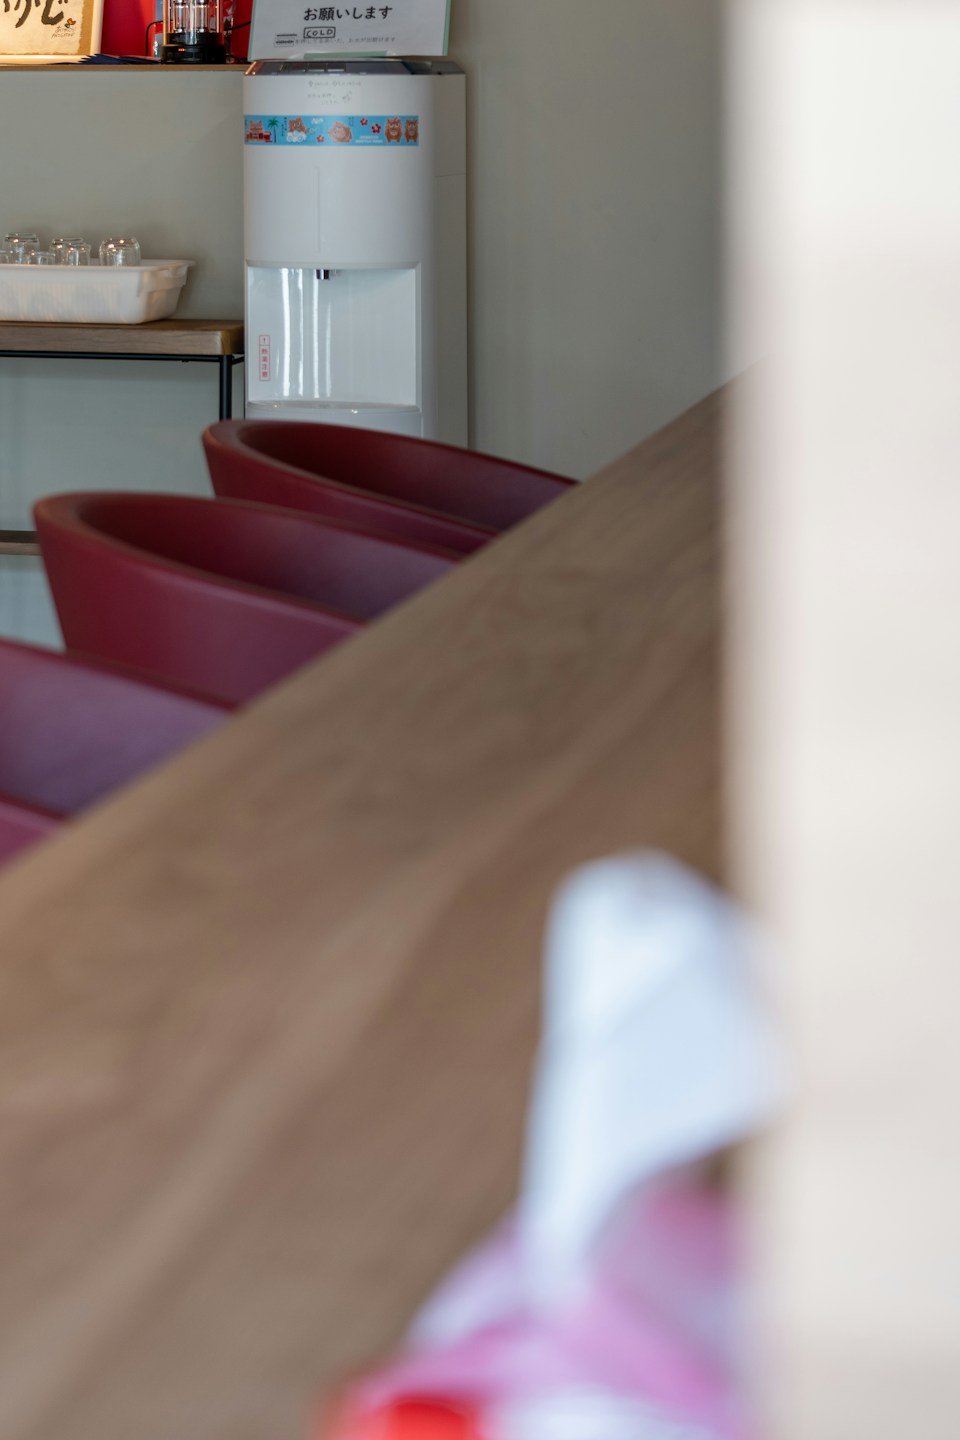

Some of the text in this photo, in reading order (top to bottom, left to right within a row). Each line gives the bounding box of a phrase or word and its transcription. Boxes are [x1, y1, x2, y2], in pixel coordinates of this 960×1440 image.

[304, 5, 393, 22] お願いします
[306, 28, 333, 36] COLD
